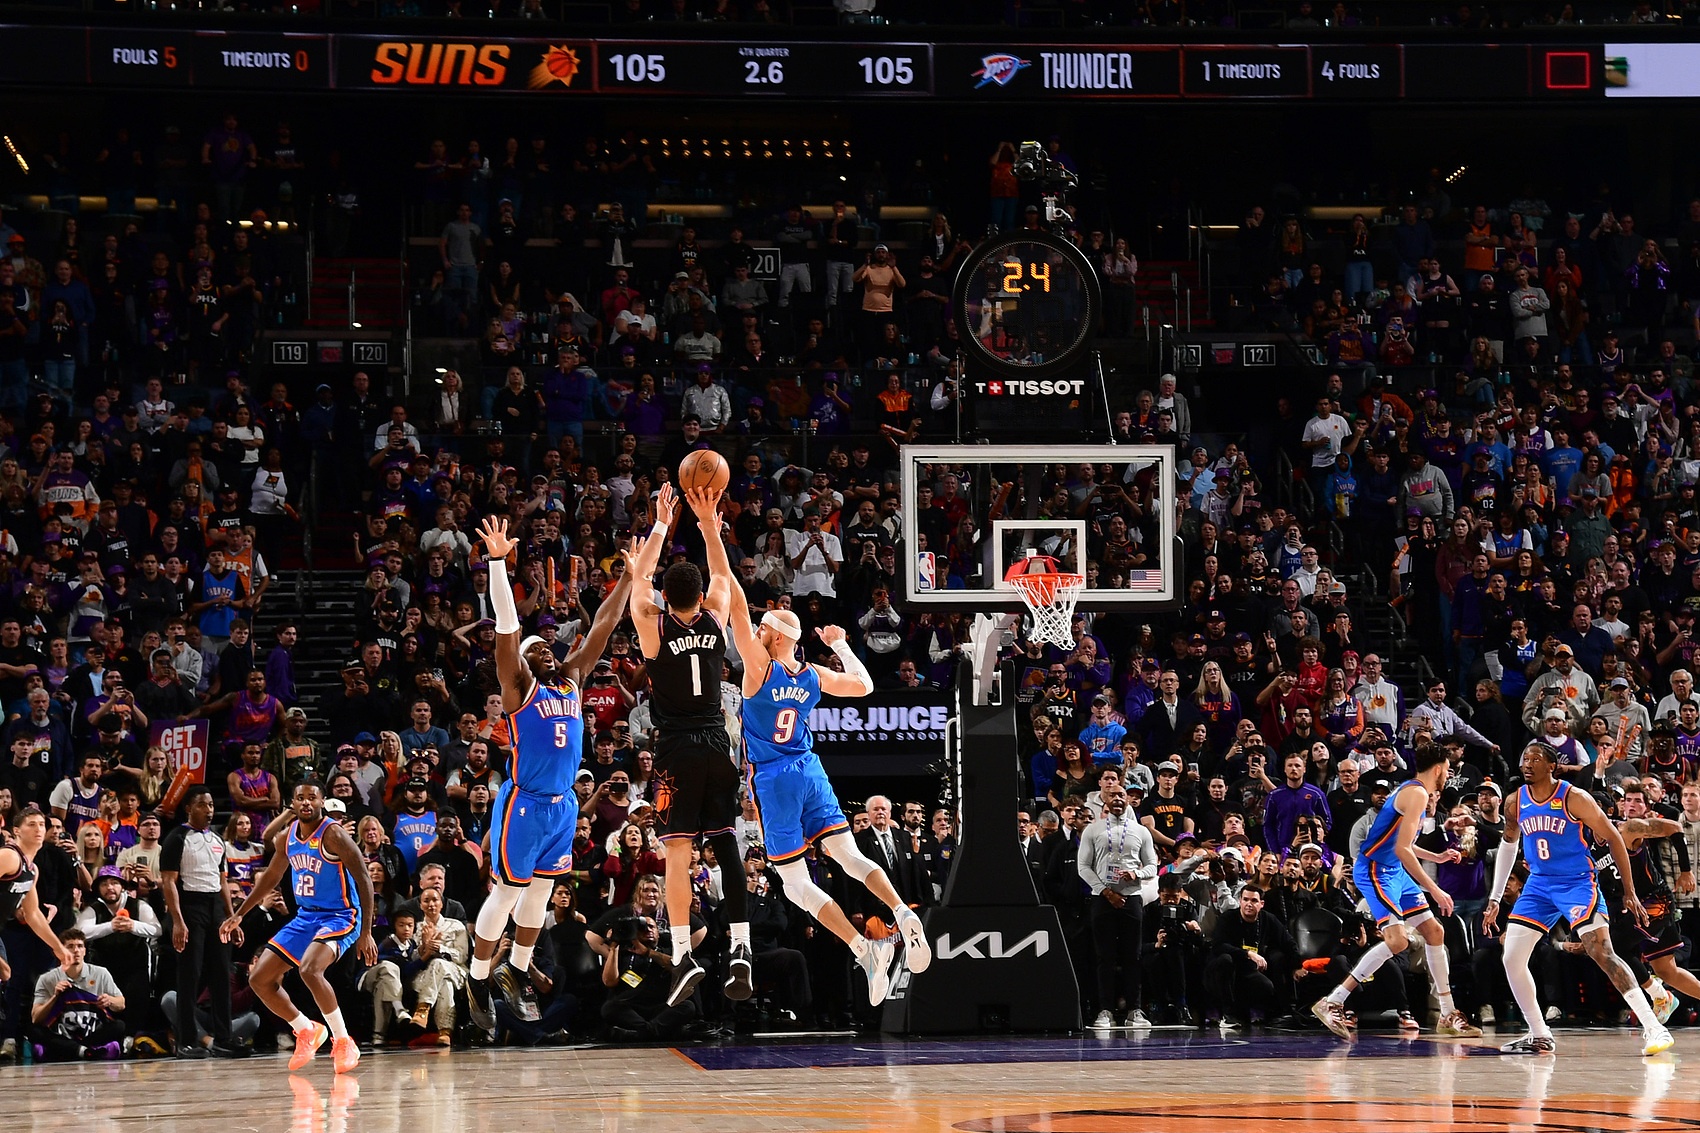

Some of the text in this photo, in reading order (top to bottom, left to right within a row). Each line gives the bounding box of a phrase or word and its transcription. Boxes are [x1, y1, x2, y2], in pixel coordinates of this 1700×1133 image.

[112, 46, 178, 69] FOULS 5
[221, 50, 309, 72] TIMEOUTS 0
[738, 47, 790, 57] 4TH QUARTER
[370, 42, 511, 86] SUNS
[608, 54, 666, 82] 105
[744, 61, 785, 84] 2.6
[857, 56, 914, 84] 105
[1040, 53, 1133, 89] THUNDER
[1202, 61, 1282, 82] 1 TIMEOUTS
[1321, 61, 1381, 81] 4 FOULS
[754, 254, 775, 274] 20
[1002, 261, 1052, 292] 2.4
[279, 345, 303, 361] 119
[359, 345, 383, 361] 120
[1249, 348, 1271, 364] 121
[976, 379, 1085, 395] T TISSOT
[668, 634, 717, 653] BOOKER
[690, 653, 703, 697] 1
[771, 687, 811, 706] CARUSO
[773, 708, 797, 745] 9
[807, 706, 948, 732] IN&JUICE
[160, 725, 197, 751] GET
[554, 722, 567, 749] 5
[817, 732, 849, 742] DRE
[855, 732, 889, 741] AND
[401, 823, 436, 837] THUNDER
[1520, 819, 1566, 837] THUNDER
[413, 837, 422, 851] 8
[1536, 837, 1550, 861] 8
